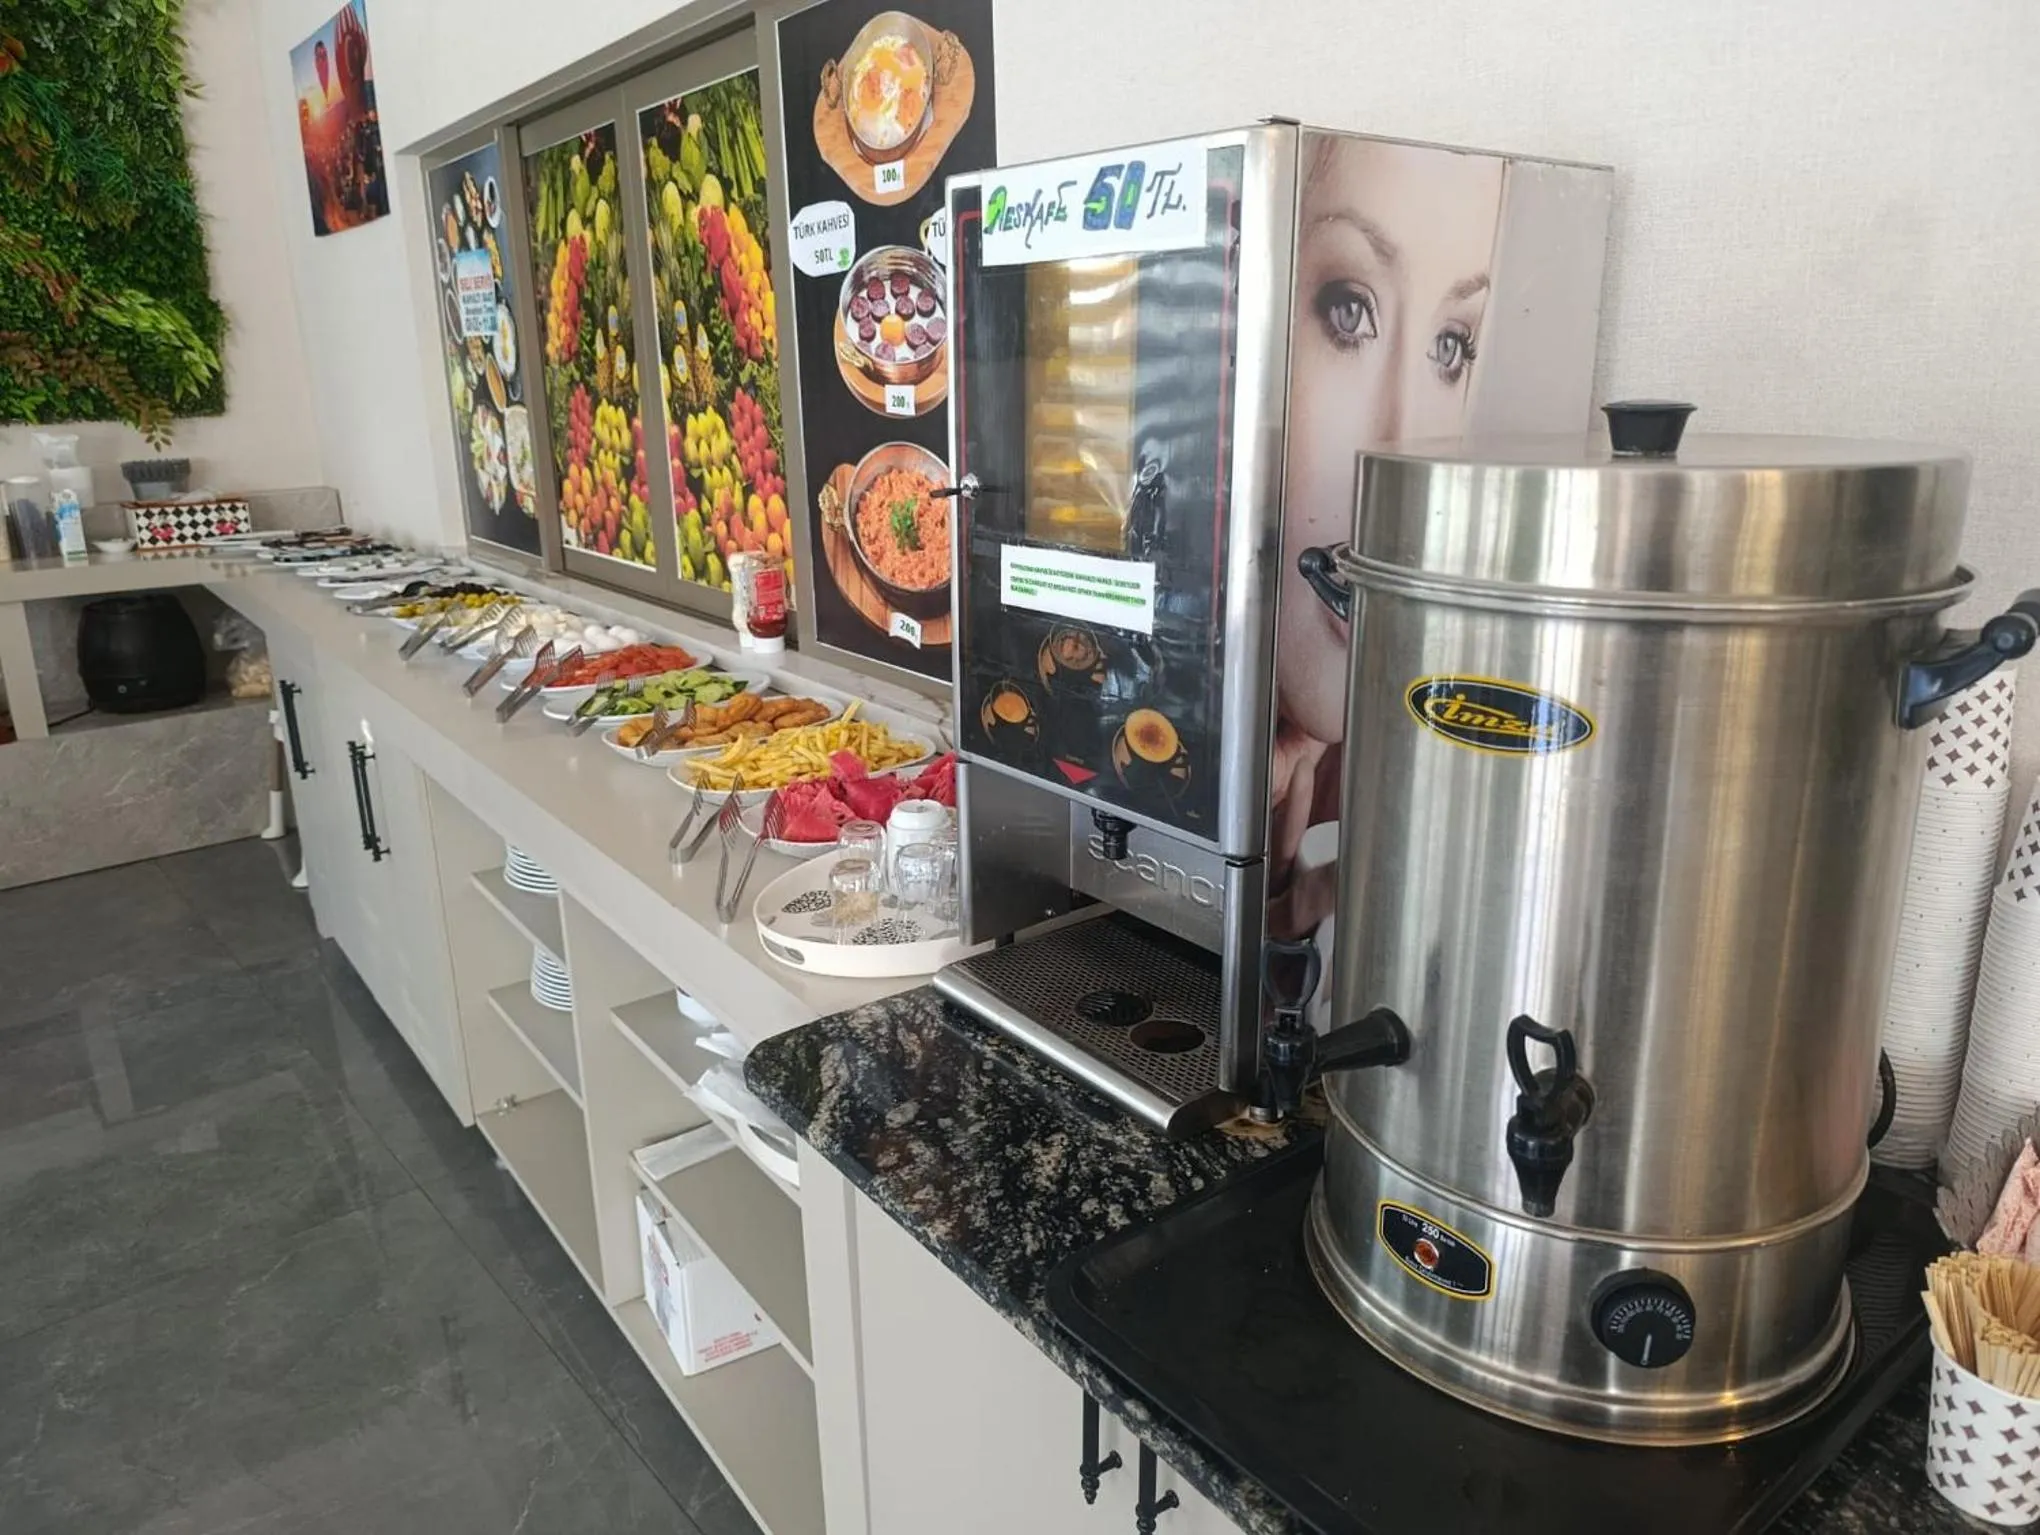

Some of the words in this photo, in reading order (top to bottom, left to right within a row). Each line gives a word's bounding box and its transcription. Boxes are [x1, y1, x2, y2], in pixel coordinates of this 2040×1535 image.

[1082, 160, 1146, 231] 50
[793, 219, 815, 240] TÜRK
[932, 218, 945, 238] TÜ
[1422, 1222, 1440, 1239] 250
